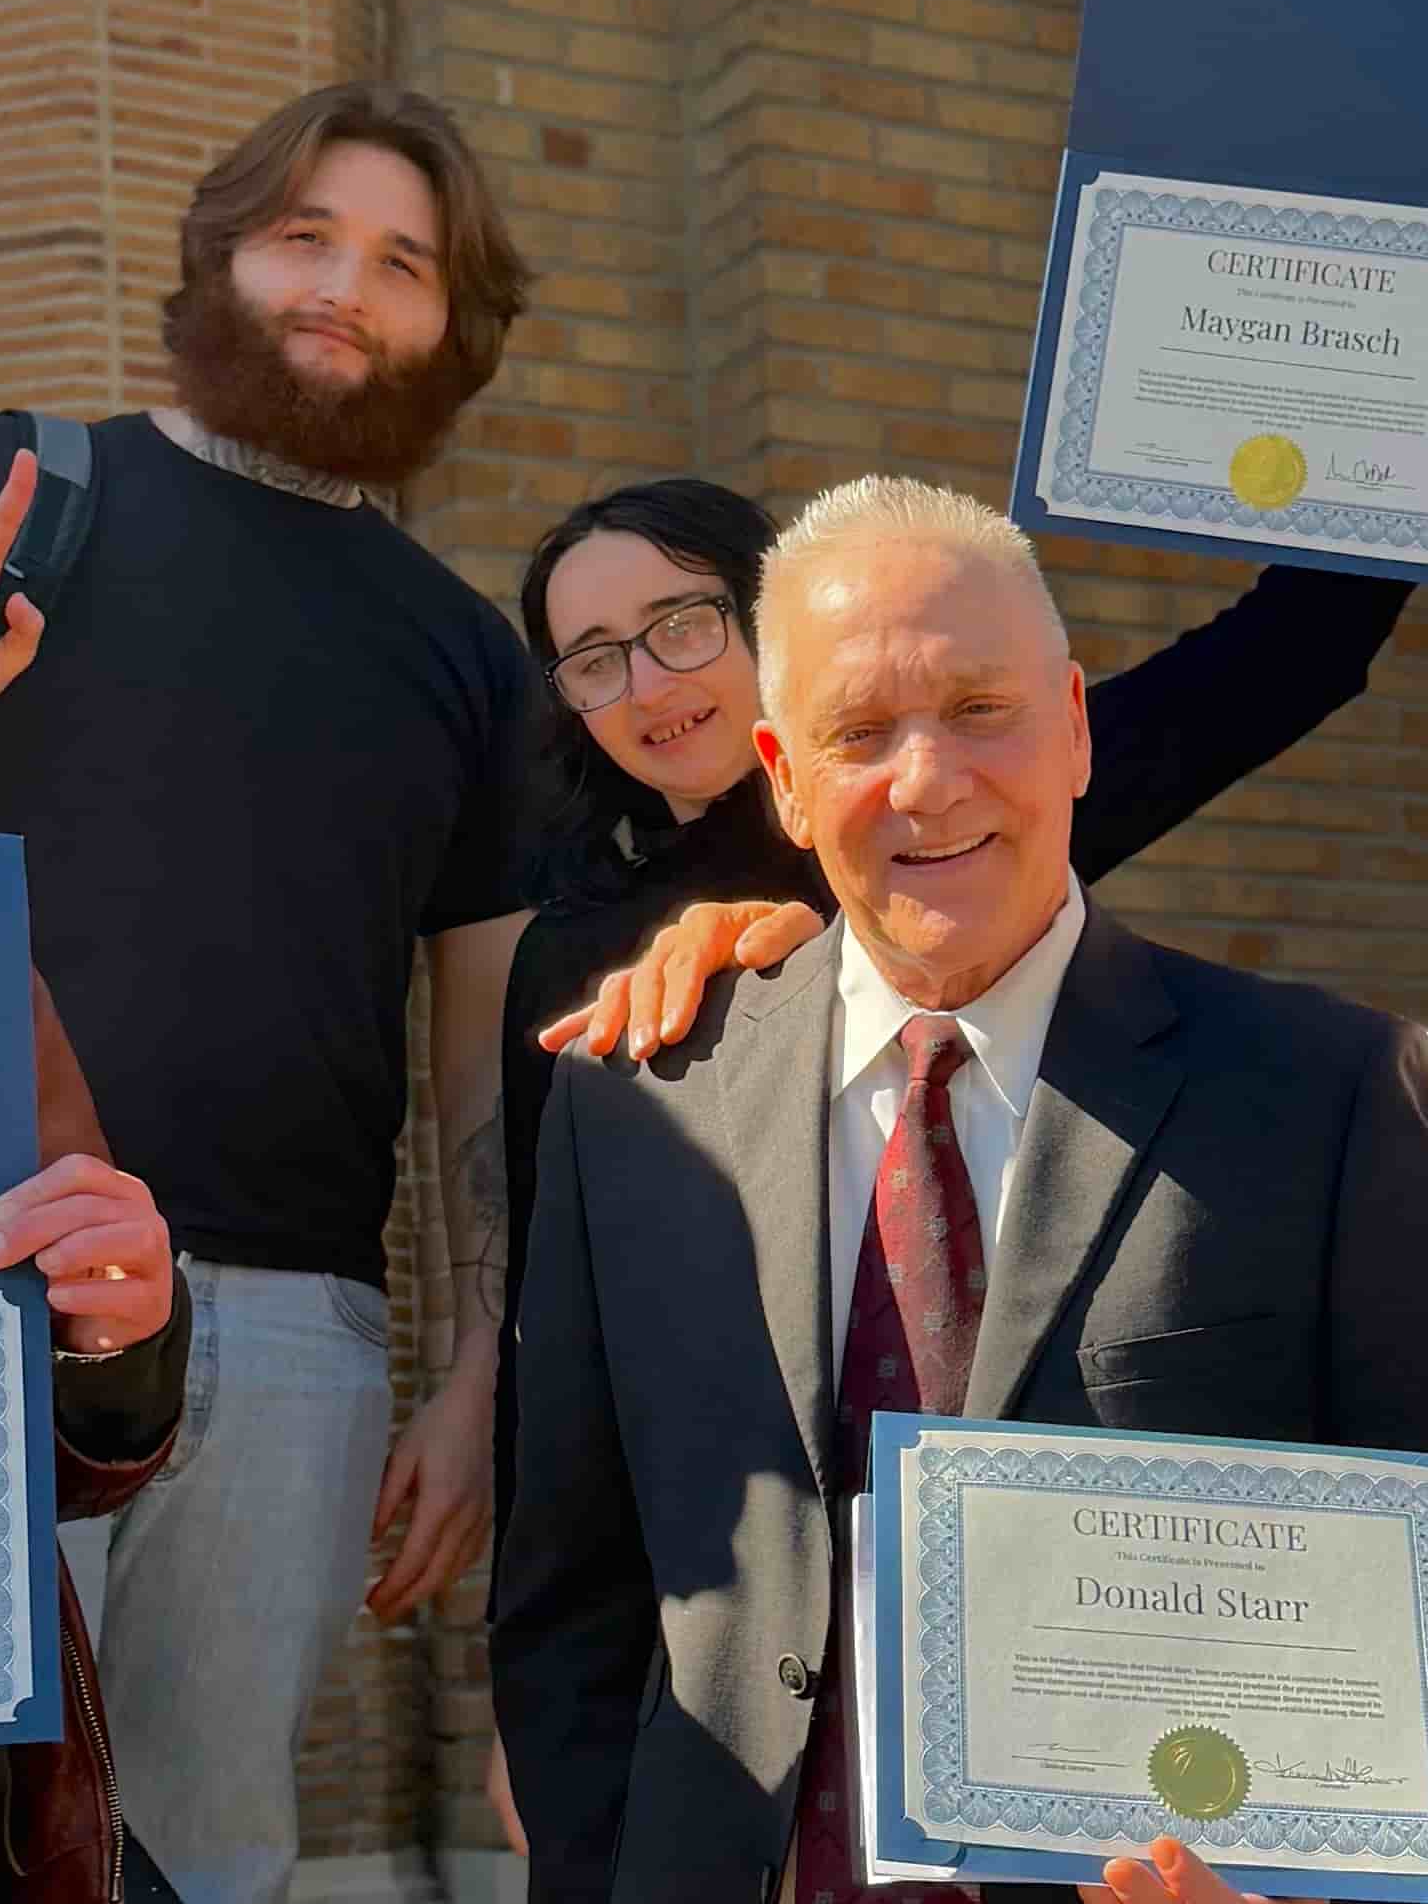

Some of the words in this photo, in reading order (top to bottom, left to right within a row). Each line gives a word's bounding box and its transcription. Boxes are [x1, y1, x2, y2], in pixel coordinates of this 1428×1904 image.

[1207, 249, 1397, 294] CERTIFICATE
[1180, 304, 1292, 345] Maygan
[1300, 319, 1401, 356] Brasch
[1073, 1507, 1308, 1552] CERTIFICATE
[1075, 1576, 1204, 1616] Donald
[1217, 1587, 1309, 1623] Starr
